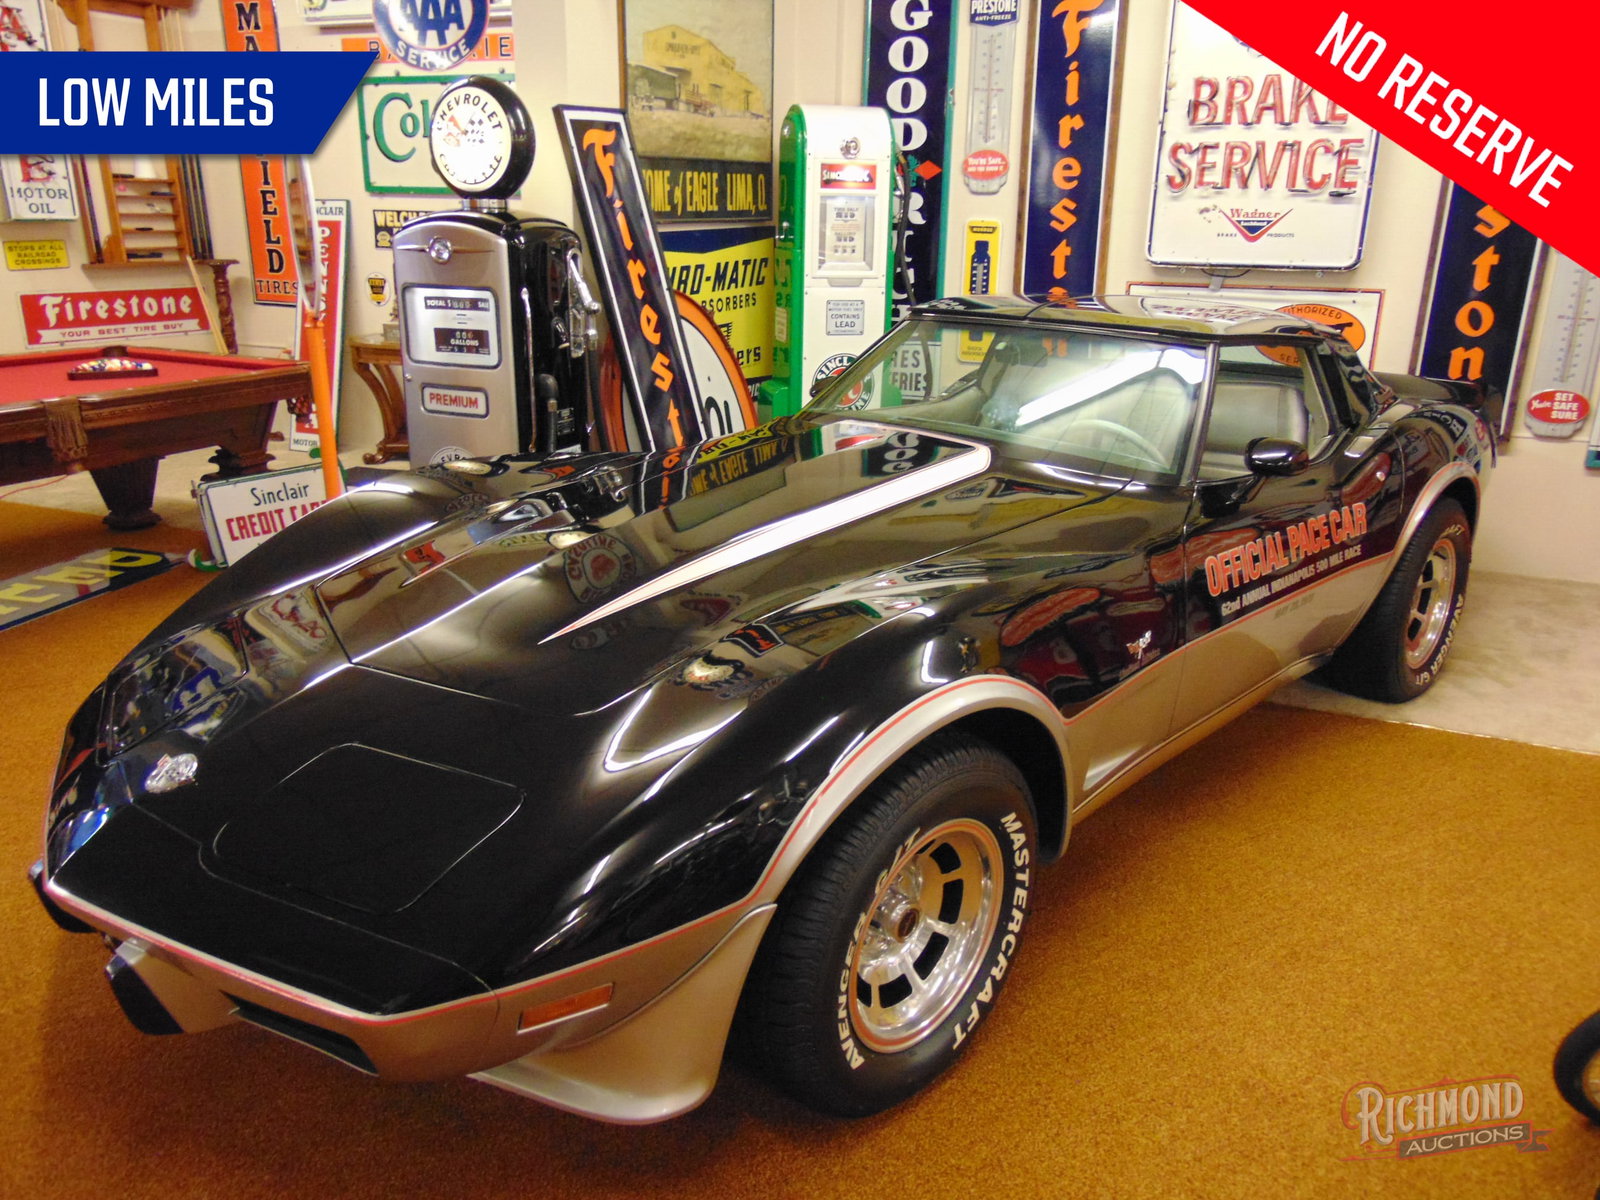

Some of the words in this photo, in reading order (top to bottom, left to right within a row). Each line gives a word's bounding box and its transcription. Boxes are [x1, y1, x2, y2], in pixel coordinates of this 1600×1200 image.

[971, 0, 1016, 14] PRESTONE
[401, 0, 465, 46] AAA
[397, 39, 470, 70] SERVICE
[437, 93, 503, 131] CHEVROLET
[1047, 0, 1104, 303] Firest
[1167, 138, 1364, 190] SERVICE
[10, 187, 68, 199] MOTOR
[643, 170, 672, 211] OME
[686, 171, 718, 212] EAGLE
[28, 203, 56, 213] OIL
[1230, 208, 1280, 219] Wagner
[256, 280, 298, 296] TIRES
[582, 128, 683, 450] Firest
[39, 294, 192, 328] Firestone
[1286, 305, 1342, 319] THORIZED
[60, 330, 91, 338] YOUR
[98, 327, 126, 335] BEST
[133, 324, 158, 332] TIRE
[163, 322, 184, 330] BUY
[816, 356, 851, 380] SINCL
[429, 391, 479, 409] PREMIUM
[1552, 402, 1579, 410] SAFE
[1554, 392, 1574, 401] SET
[1550, 410, 1579, 420] SURE
[250, 482, 309, 506] Sinclair
[226, 508, 286, 541] CREDIT
[1204, 532, 1289, 597] OFFICIAL
[1286, 514, 1330, 563] PACE
[1328, 502, 1367, 544] CAR
[1221, 596, 1241, 616] 62nd
[1241, 584, 1271, 607] ANNUAL
[1270, 564, 1315, 594] INDIANAPOLIS
[1316, 558, 1329, 573] 500
[1329, 551, 1344, 567] MILE
[1344, 544, 1362, 560] RACE
[952, 812, 1030, 1050] MASTERCRAFT
